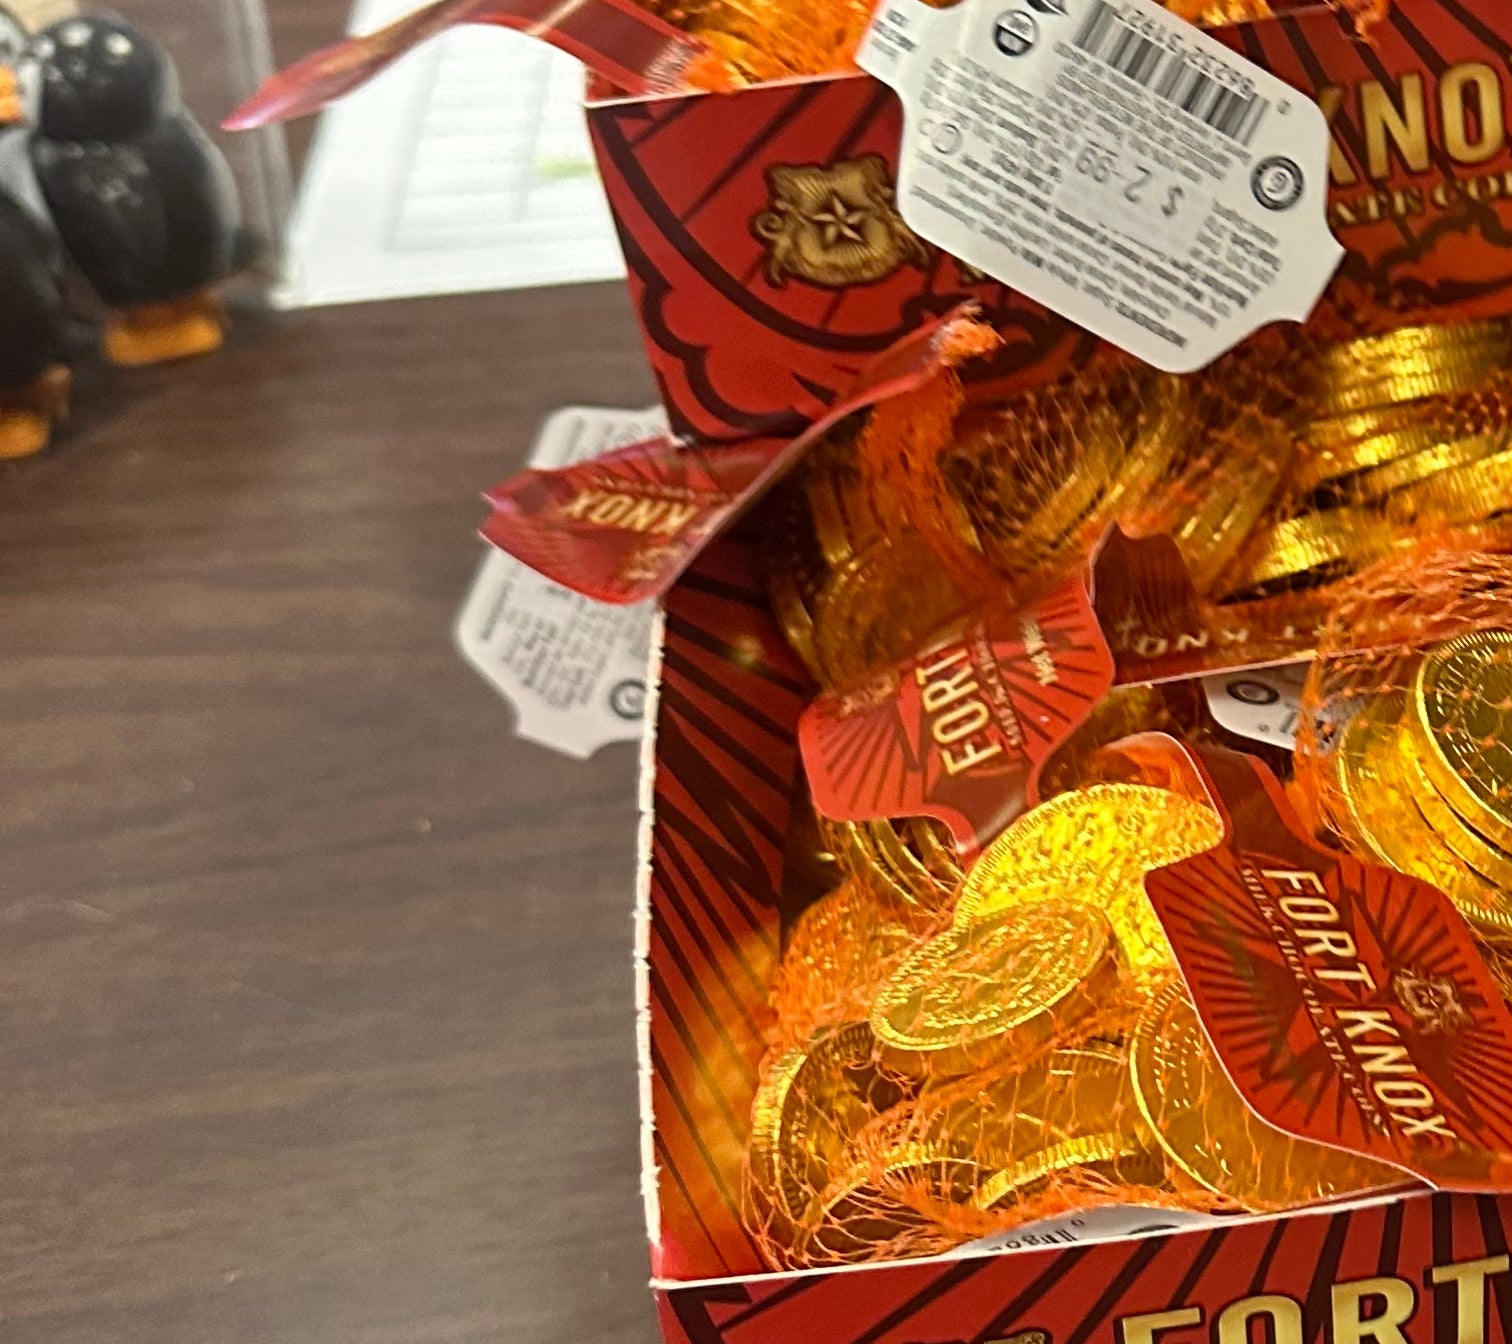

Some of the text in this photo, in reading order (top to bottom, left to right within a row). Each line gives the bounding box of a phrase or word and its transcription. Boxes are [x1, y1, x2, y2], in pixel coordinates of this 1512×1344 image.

[914, 644, 1002, 776] FORT
[1262, 865, 1455, 1146] FORT KNOX
